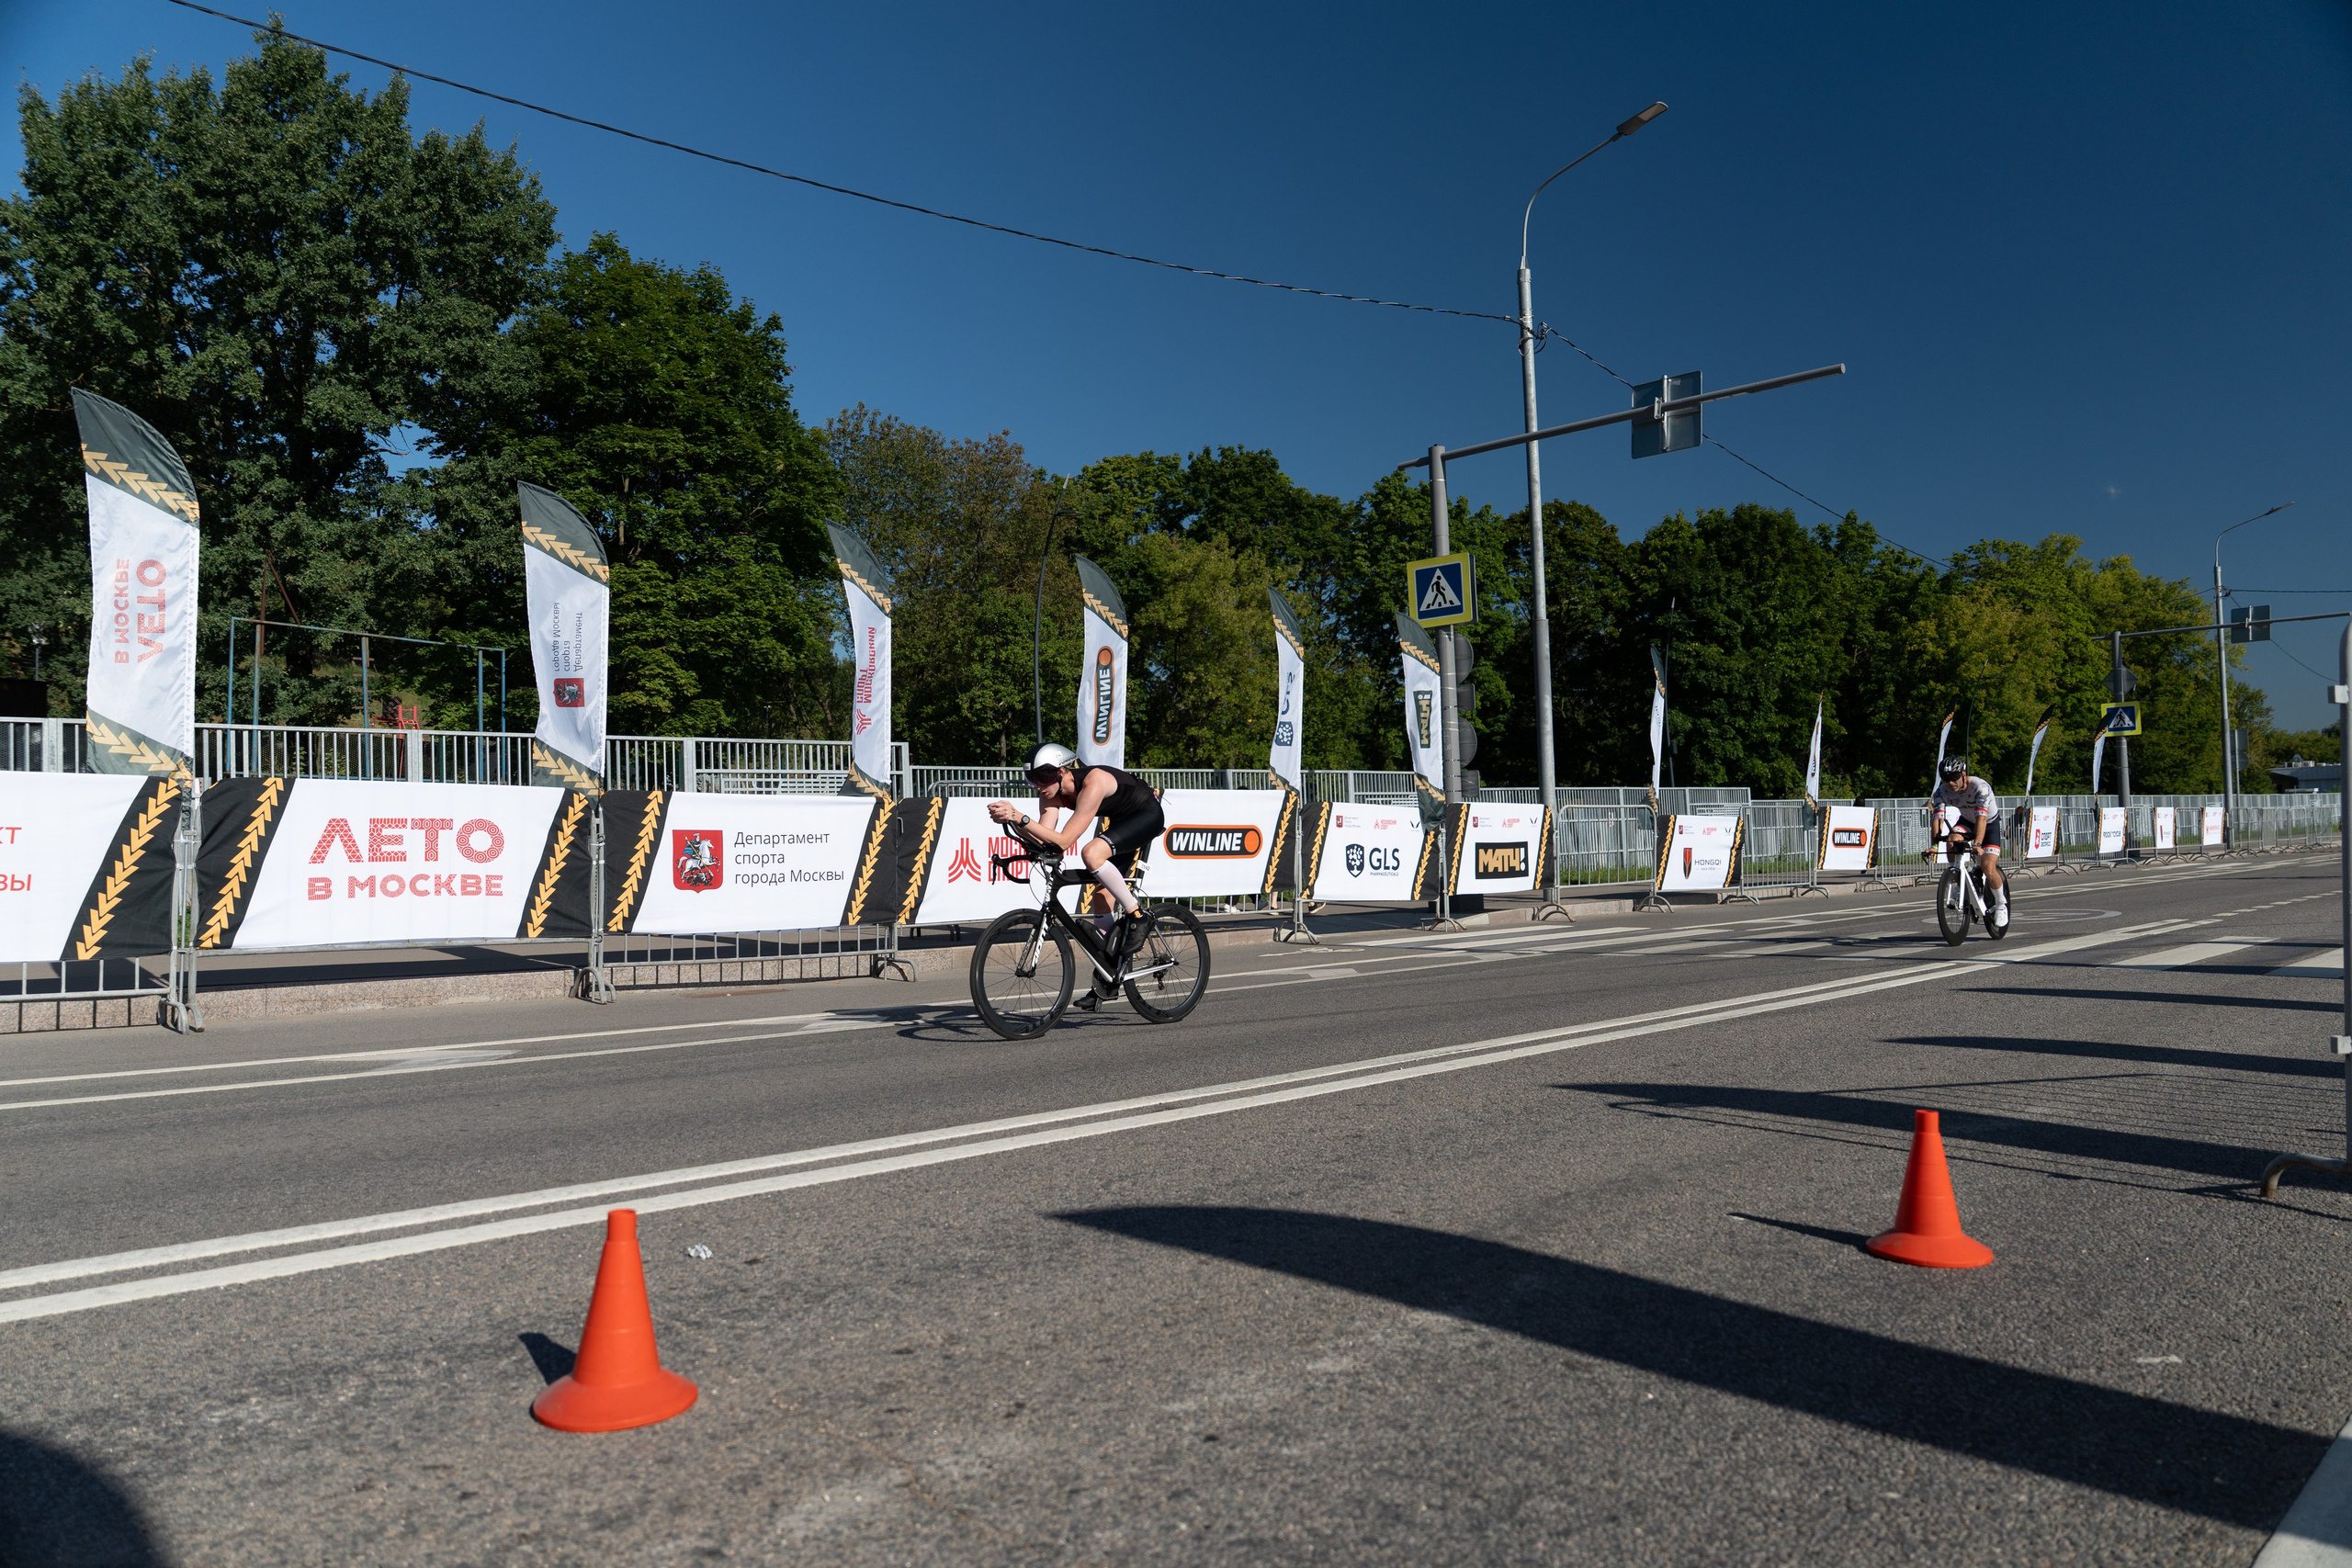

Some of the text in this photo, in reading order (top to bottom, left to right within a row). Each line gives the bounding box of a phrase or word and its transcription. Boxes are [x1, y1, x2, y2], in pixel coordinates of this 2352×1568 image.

[309, 818, 504, 863] ЛЕТО
[734, 831, 830, 848] Департамент
[1172, 832, 1242, 852] WINLINE
[1834, 832, 1860, 844] WINLINE
[735, 853, 785, 867] спорта
[1369, 847, 1400, 871] GLS
[1478, 847, 1525, 873] МАТЧ!
[308, 874, 503, 900] В МОСКВЕ
[735, 869, 844, 887] города Москвы
